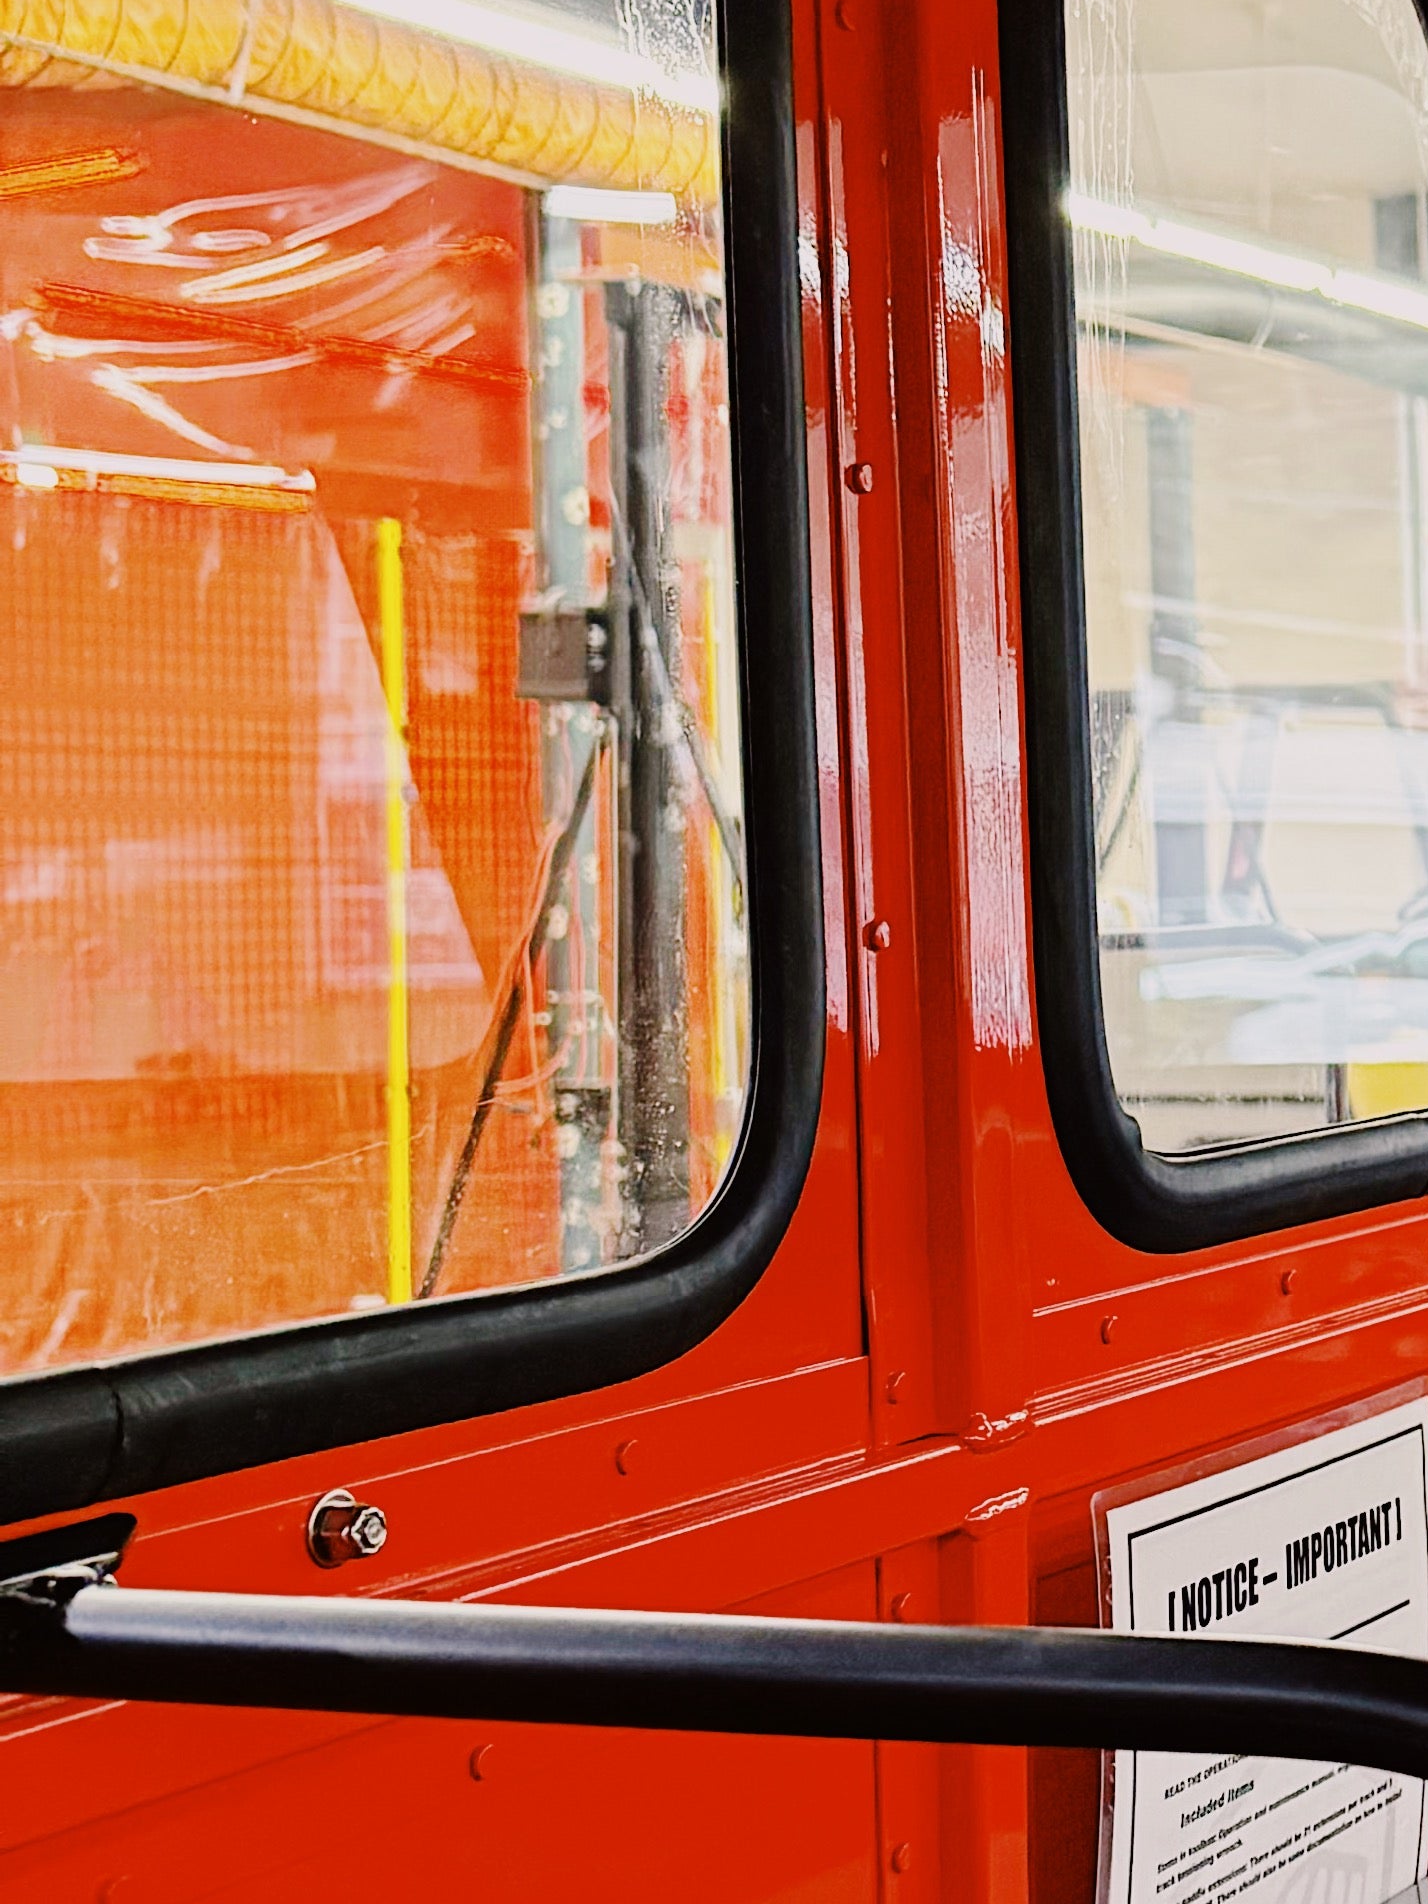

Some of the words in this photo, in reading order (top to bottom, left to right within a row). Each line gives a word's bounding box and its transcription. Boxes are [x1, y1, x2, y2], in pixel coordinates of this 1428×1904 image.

[1181, 1557, 1259, 1632] NOTICE
[1286, 1501, 1392, 1590] IMPORTANT
[1164, 1781, 1185, 1800] READ
[1181, 1792, 1225, 1828] Included
